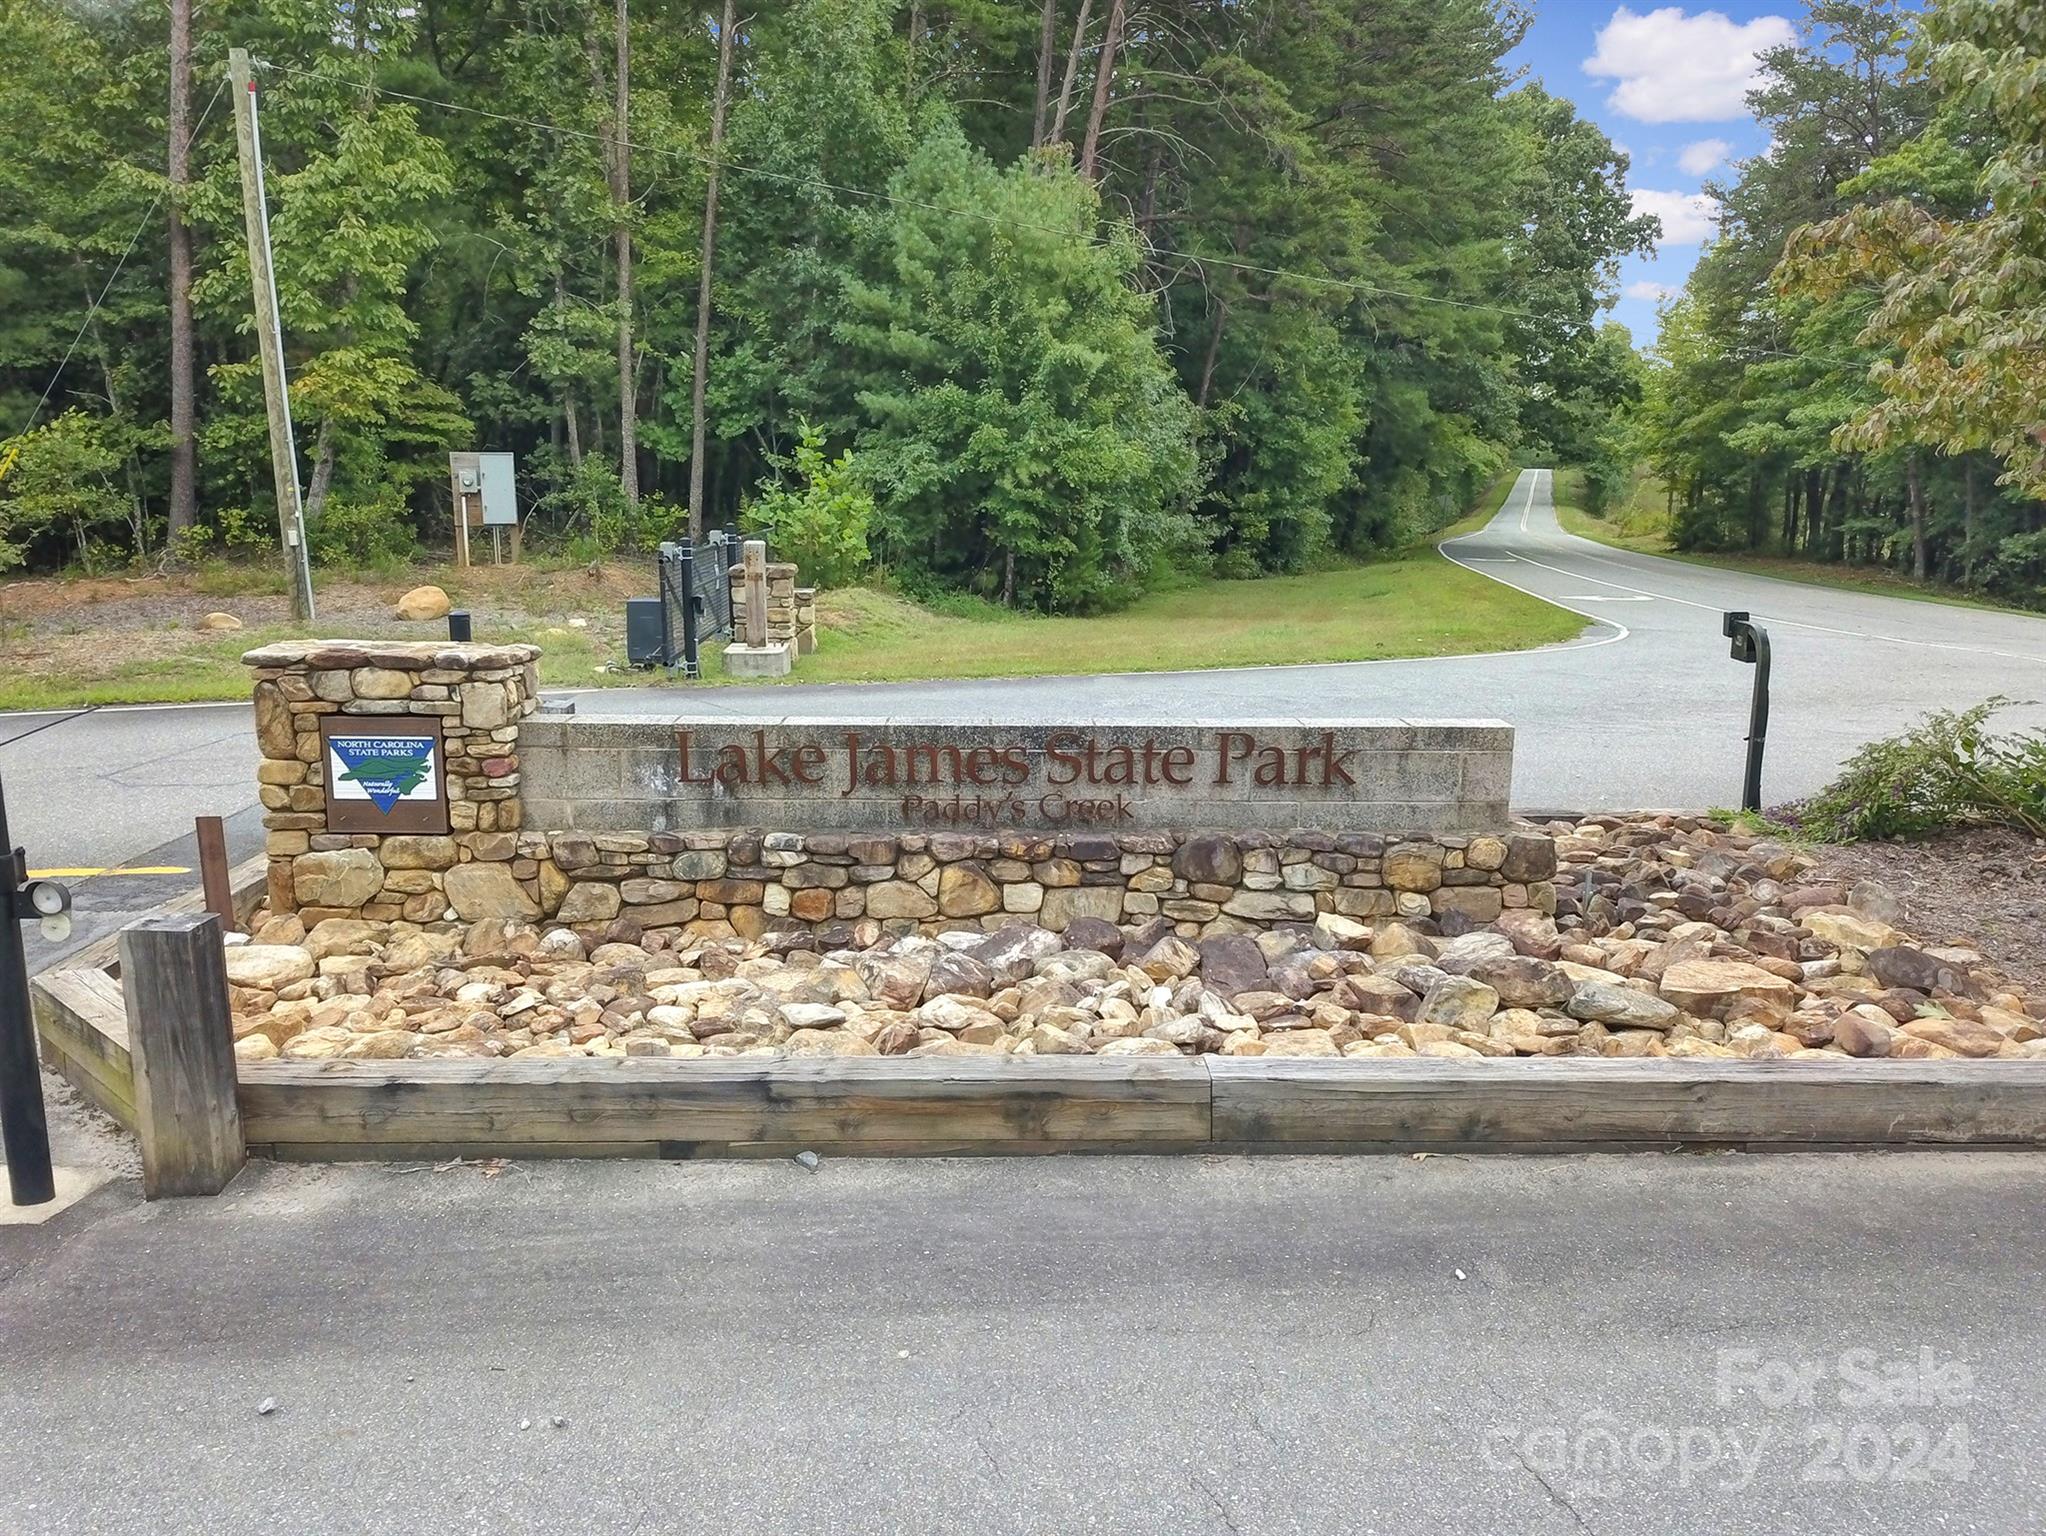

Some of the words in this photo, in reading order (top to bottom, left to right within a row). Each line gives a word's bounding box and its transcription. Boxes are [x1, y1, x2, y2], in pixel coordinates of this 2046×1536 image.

[373, 741, 424, 749] CAROLINA
[674, 729, 827, 786] Lake
[840, 730, 1031, 796] James
[1046, 731, 1195, 785] State
[1211, 731, 1357, 786] Park
[902, 791, 1026, 821] Paddy's
[1039, 792, 1134, 821] Creek
